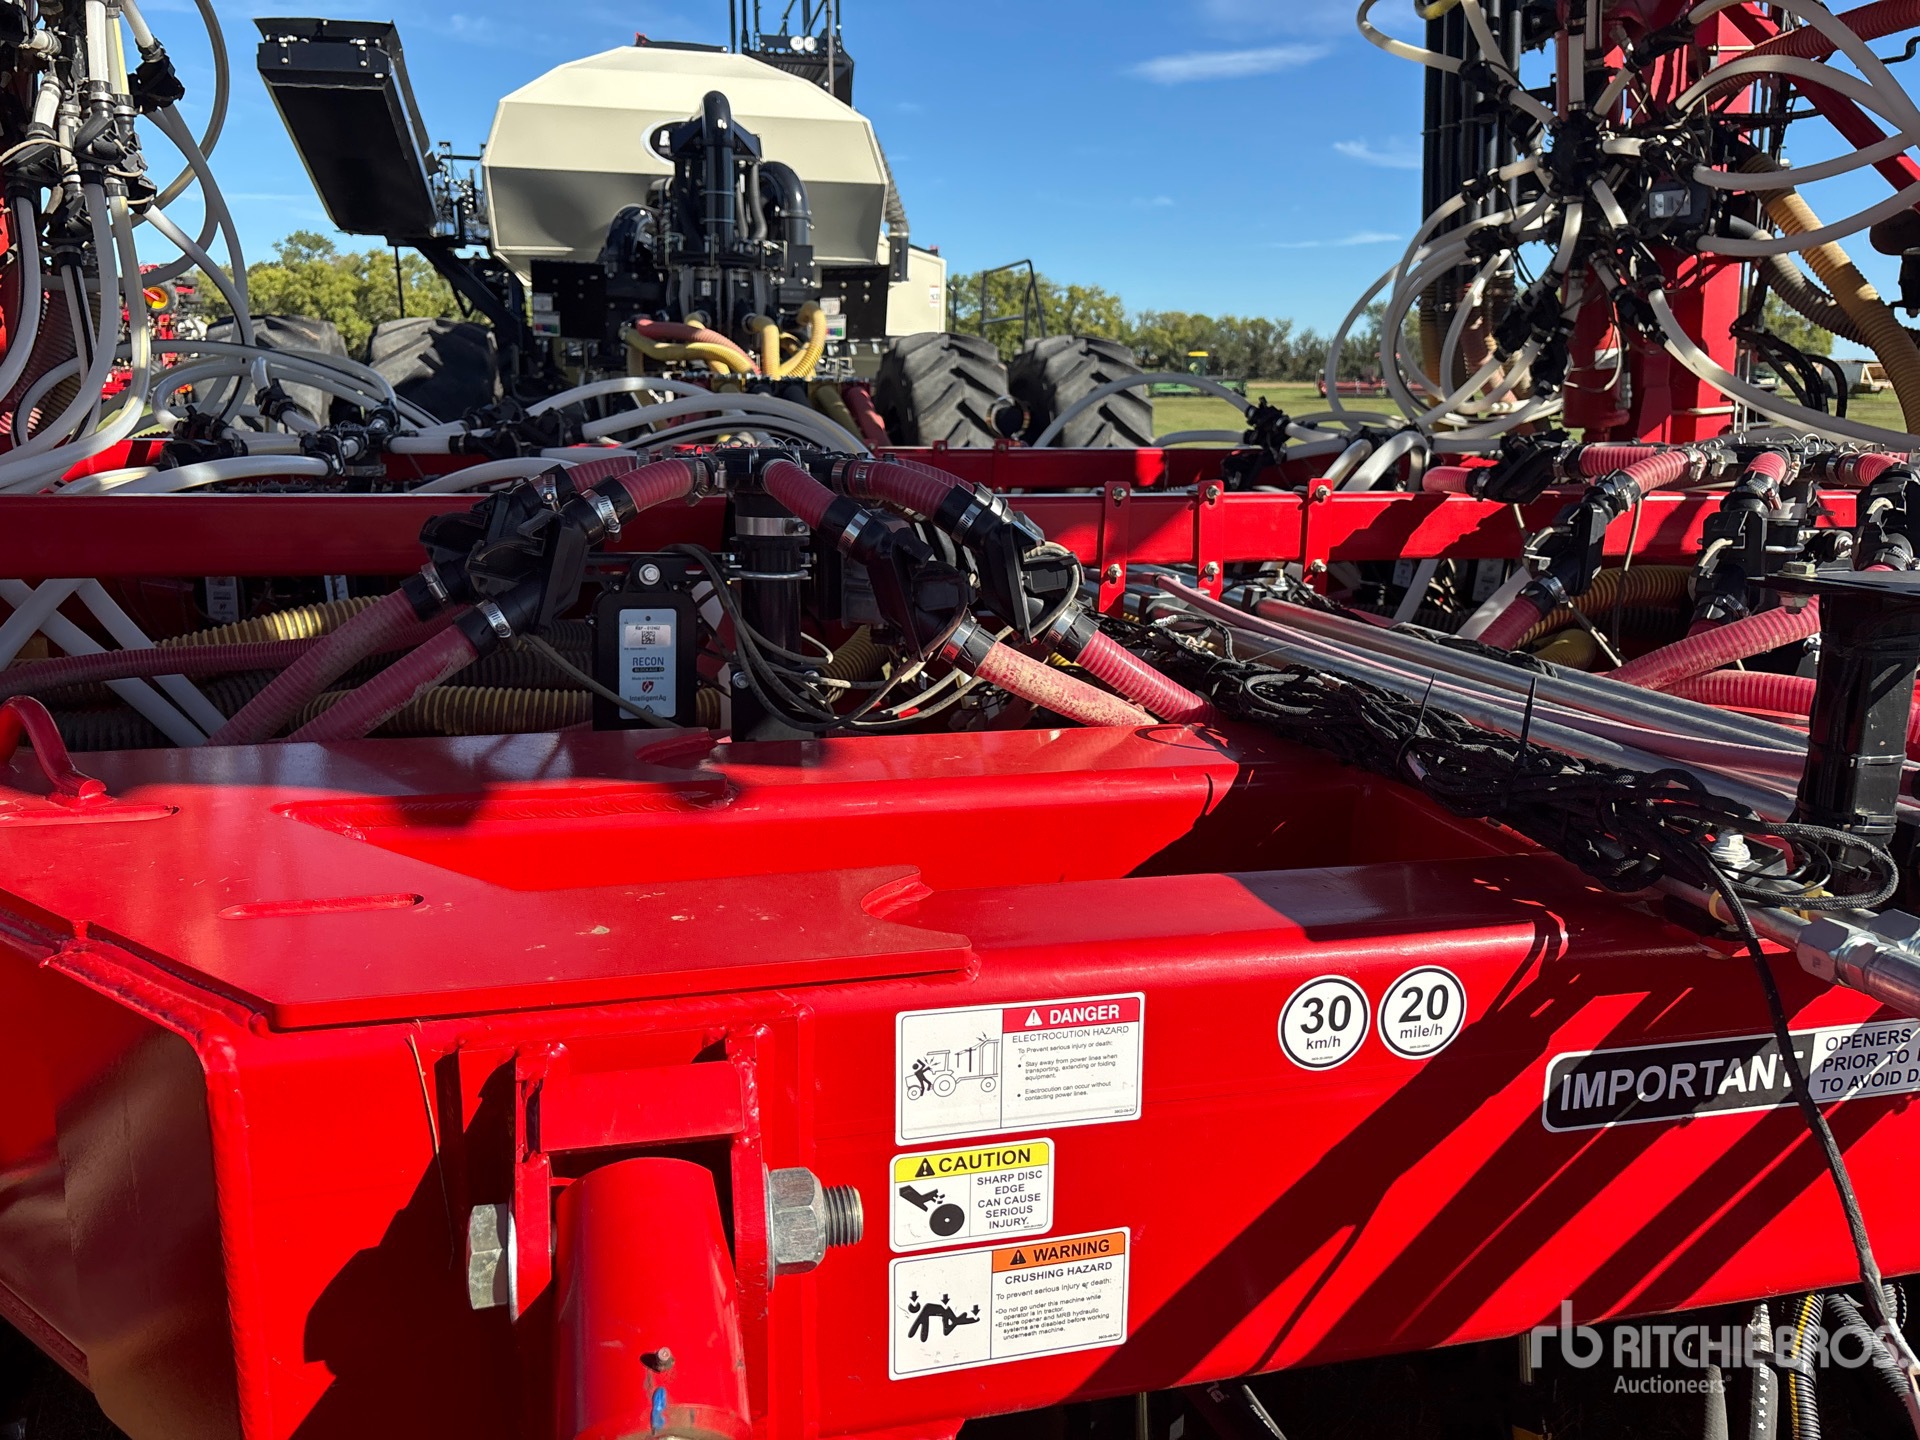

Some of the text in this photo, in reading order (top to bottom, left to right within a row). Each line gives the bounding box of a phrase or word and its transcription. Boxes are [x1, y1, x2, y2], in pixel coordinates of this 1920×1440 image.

[632, 656, 664, 666] RECON
[1398, 984, 1449, 1024] 20
[1050, 1004, 1120, 1024] DANGER
[1300, 995, 1352, 1034] 30
[1012, 1026, 1129, 1043] ELECTROCUTION HAZARD
[1400, 1024, 1443, 1039] mile/h
[1826, 1028, 1912, 1051] OPENERS
[1306, 1036, 1341, 1050] km/h
[1822, 1053, 1878, 1072] PRIOR
[1887, 1049, 1909, 1065] TO
[1820, 1069, 1920, 1093] TO AVOID D
[1025, 1085, 1061, 1094] Electrocution
[1025, 1093, 1053, 1101] contacting
[939, 1148, 1030, 1172] CAUTION
[977, 1170, 1042, 1186] SHARP DISC
[995, 1184, 1025, 1195] EDGE
[978, 1193, 1041, 1208] CAN CAUSE
[986, 1205, 1033, 1218] SERIOUS
[989, 1217, 1029, 1229] INJURY.
[1033, 1239, 1110, 1262] WARNING
[1005, 1261, 1112, 1285] CRUSHING HAZARD
[1006, 1289, 1033, 1300] prevent
[1034, 1285, 1060, 1294] serious
[1061, 1283, 1080, 1291] injury
[1090, 1278, 1112, 1286] death:
[1003, 1311, 1029, 1321] operator
[1020, 1316, 1042, 1325] opener
[1072, 1308, 1099, 1317] hydraulic
[1003, 1326, 1028, 1334] systems
[1041, 1319, 1066, 1328] disabled
[1003, 1327, 1066, 1340] underneath machine.
